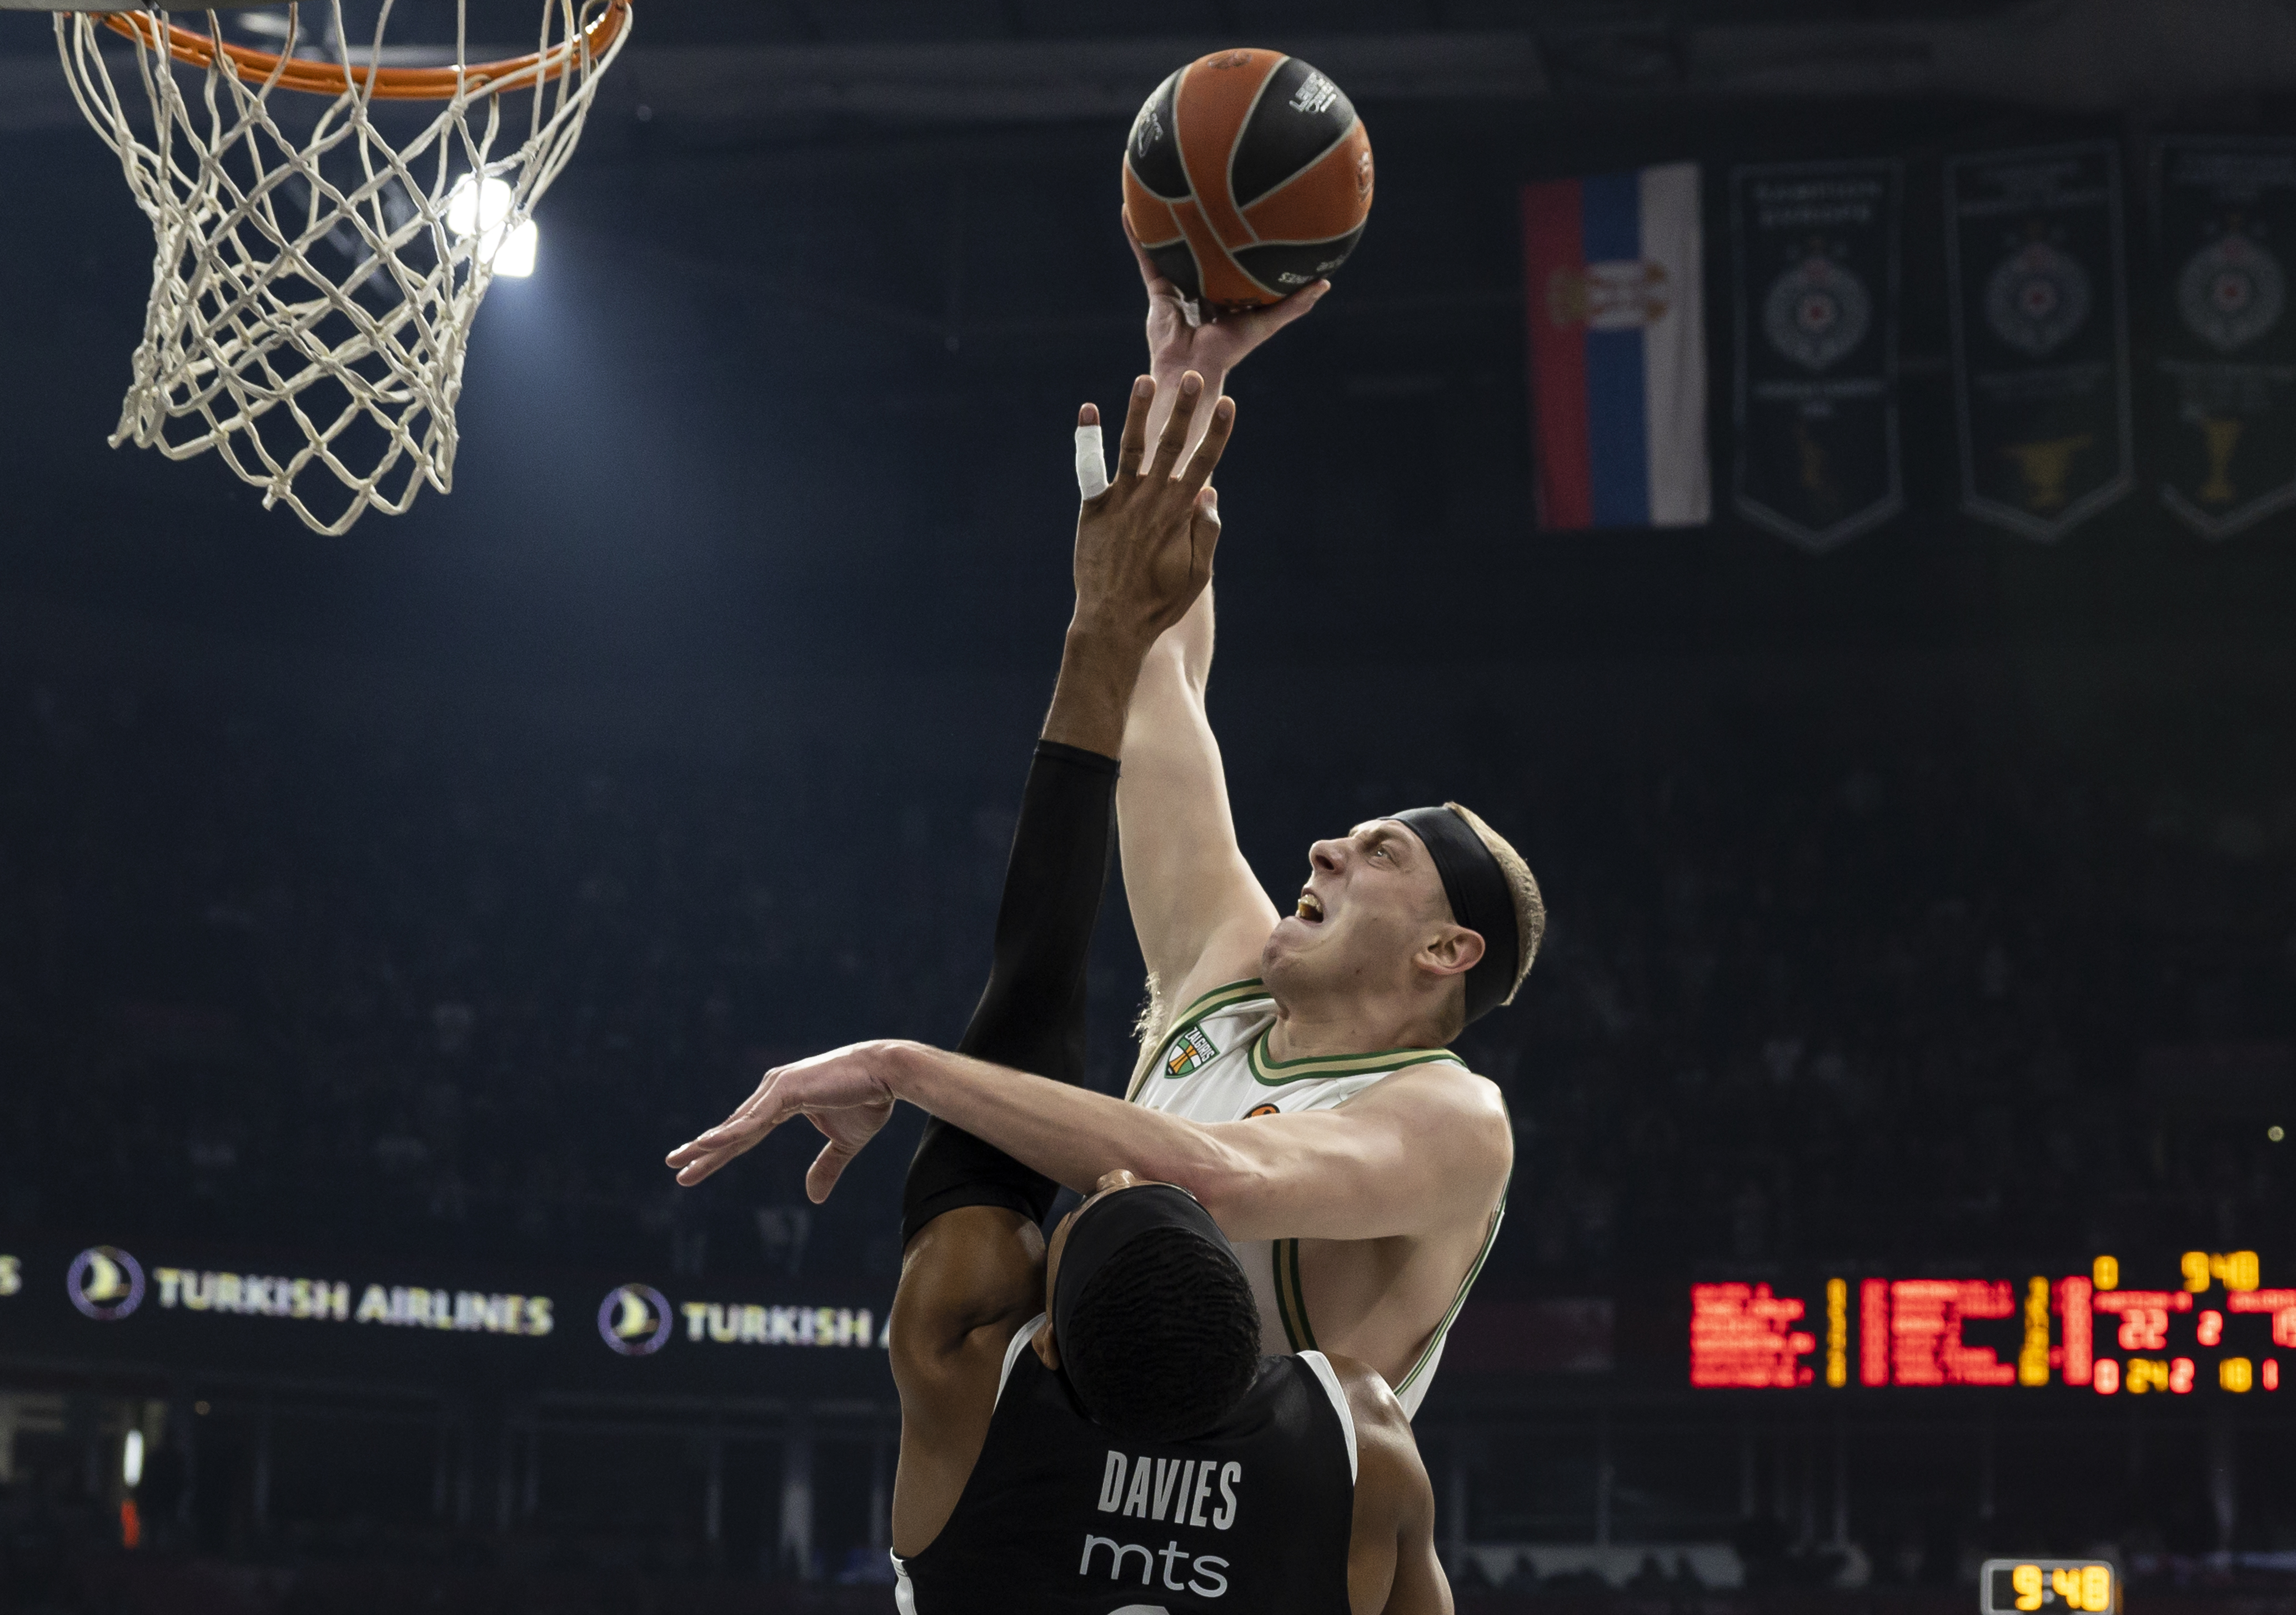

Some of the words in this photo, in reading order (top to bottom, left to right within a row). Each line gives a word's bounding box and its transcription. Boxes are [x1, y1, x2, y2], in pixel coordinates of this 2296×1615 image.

[152, 1267, 351, 1322] TURKISH
[354, 1282, 554, 1336] AIRLINES
[680, 1302, 873, 1348] TURKISH
[1097, 1450, 1241, 1530] DAVIES
[1079, 1534, 1230, 1598] mts
